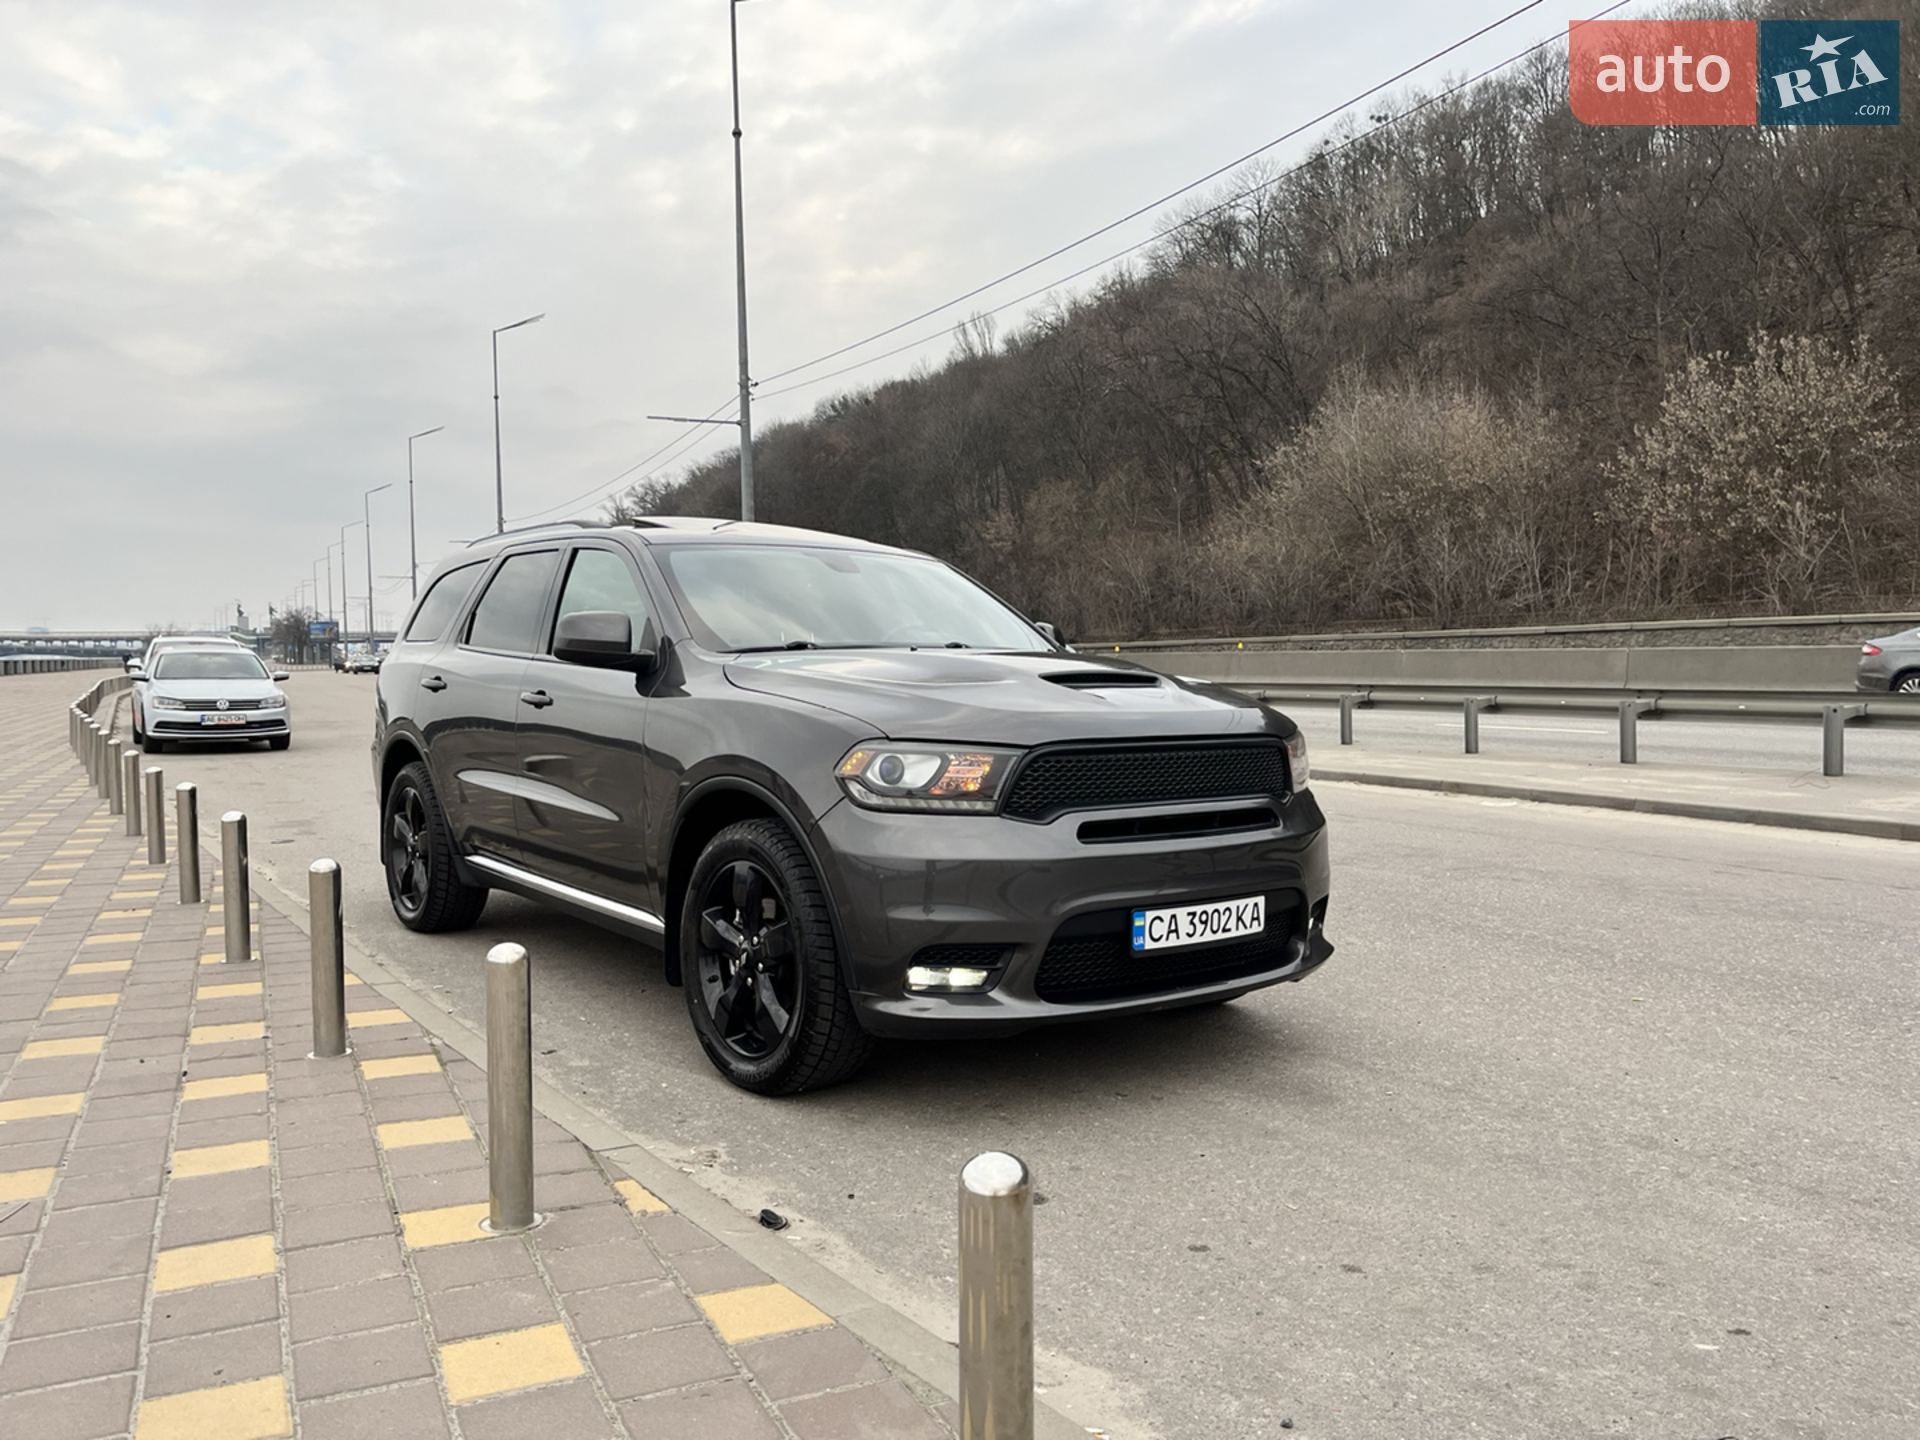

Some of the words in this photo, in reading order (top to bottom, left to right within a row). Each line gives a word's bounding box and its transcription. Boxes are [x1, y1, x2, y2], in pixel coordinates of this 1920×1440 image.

[1149, 914, 1180, 942] CA
[1185, 907, 1232, 938] 3902
[1235, 902, 1261, 931] KA
[1134, 936, 1144, 945] UA
